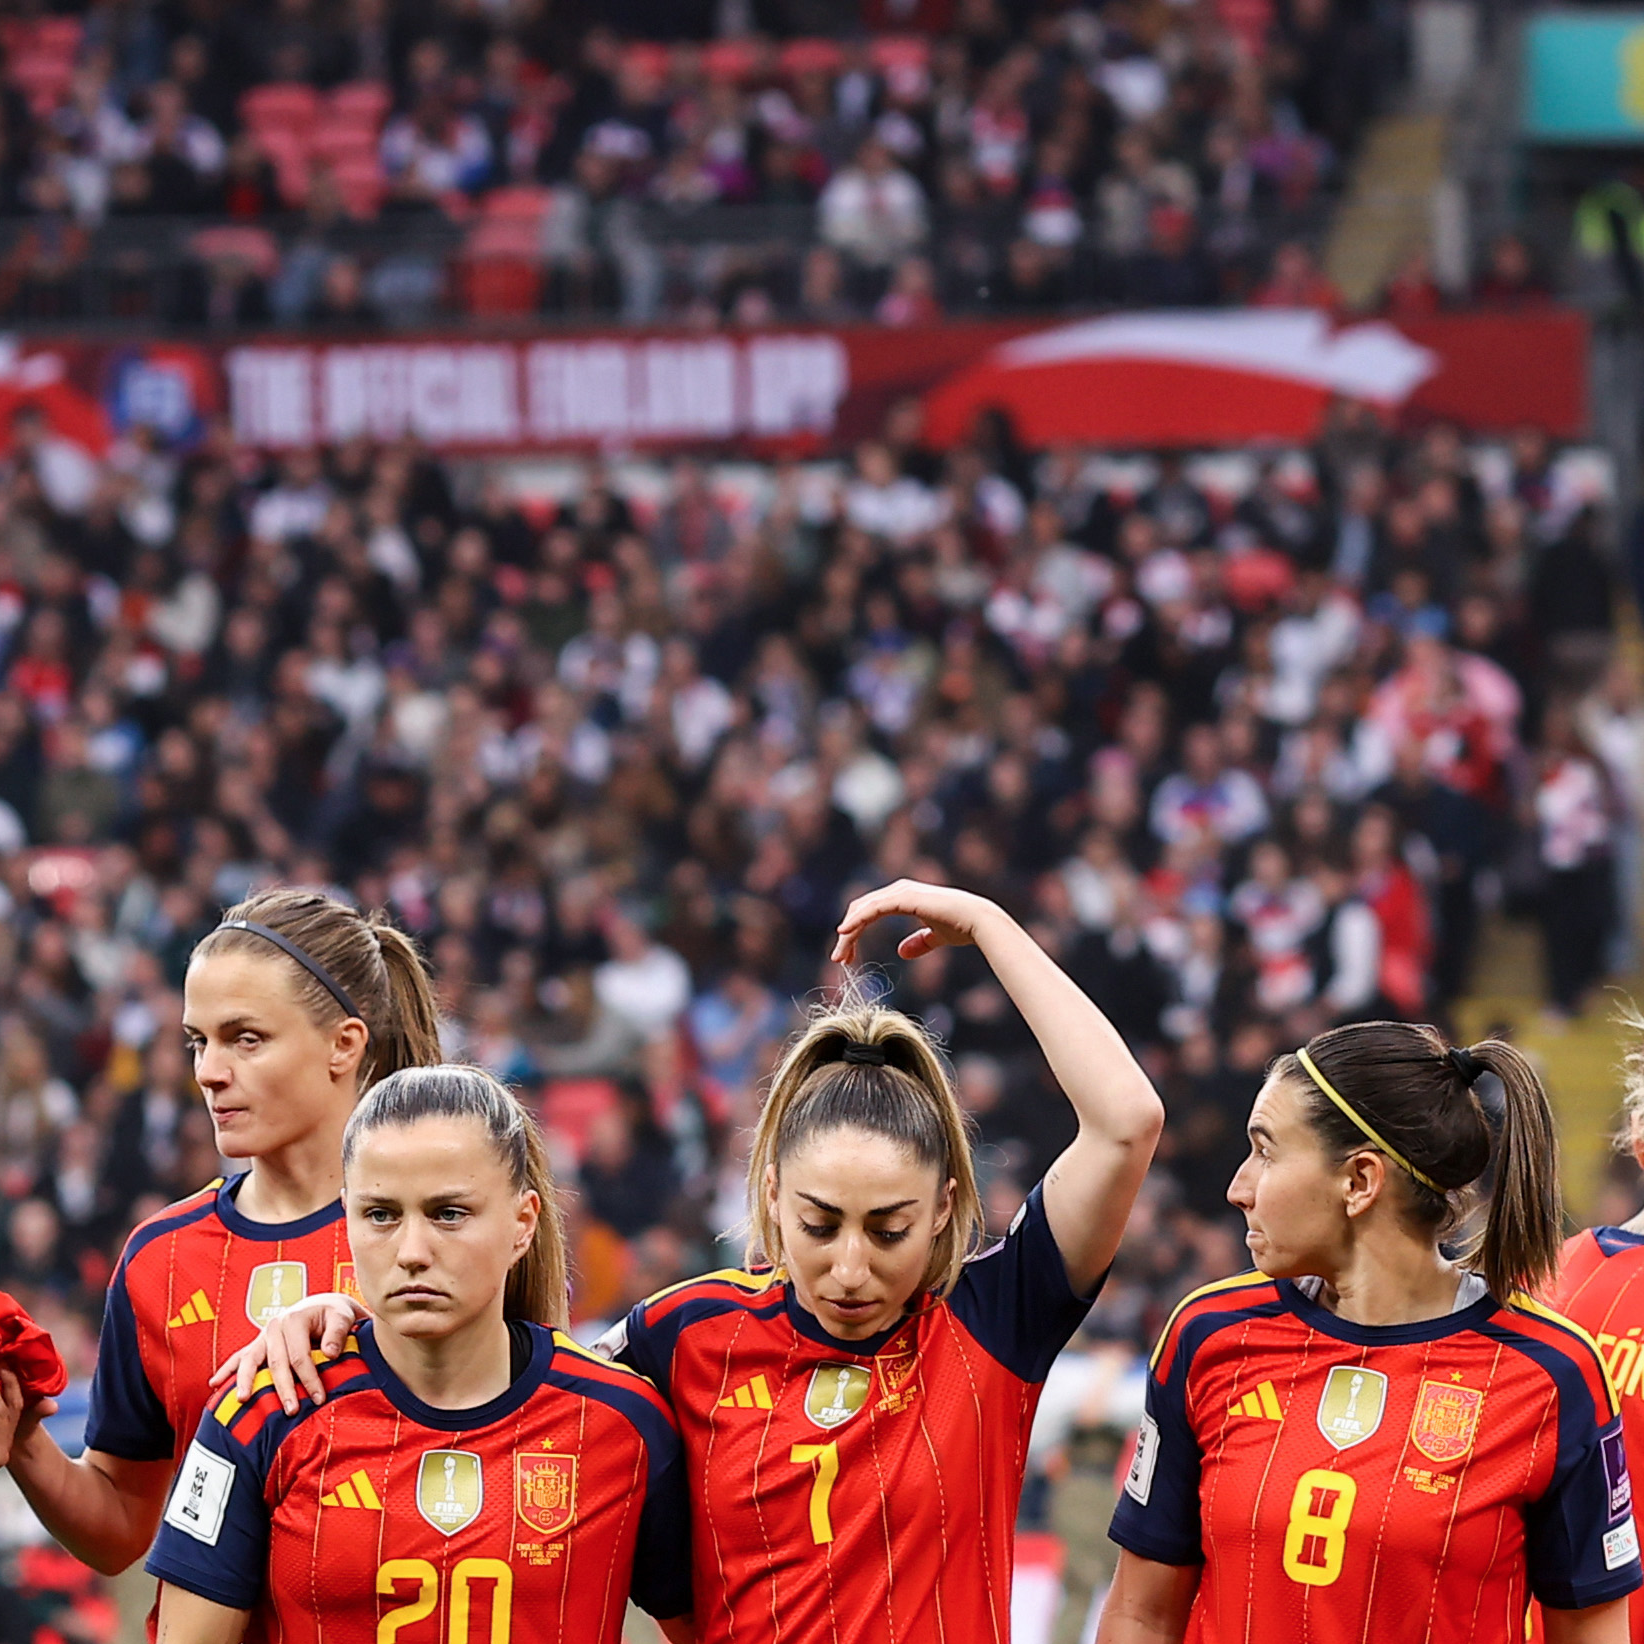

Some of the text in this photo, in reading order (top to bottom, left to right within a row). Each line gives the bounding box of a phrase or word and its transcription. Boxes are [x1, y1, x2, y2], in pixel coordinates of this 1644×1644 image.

[1332, 1417, 1361, 1432] FIFA
[434, 1501, 465, 1514] FIFA
[790, 1442, 839, 1544] 7
[1283, 1469, 1357, 1586] 8
